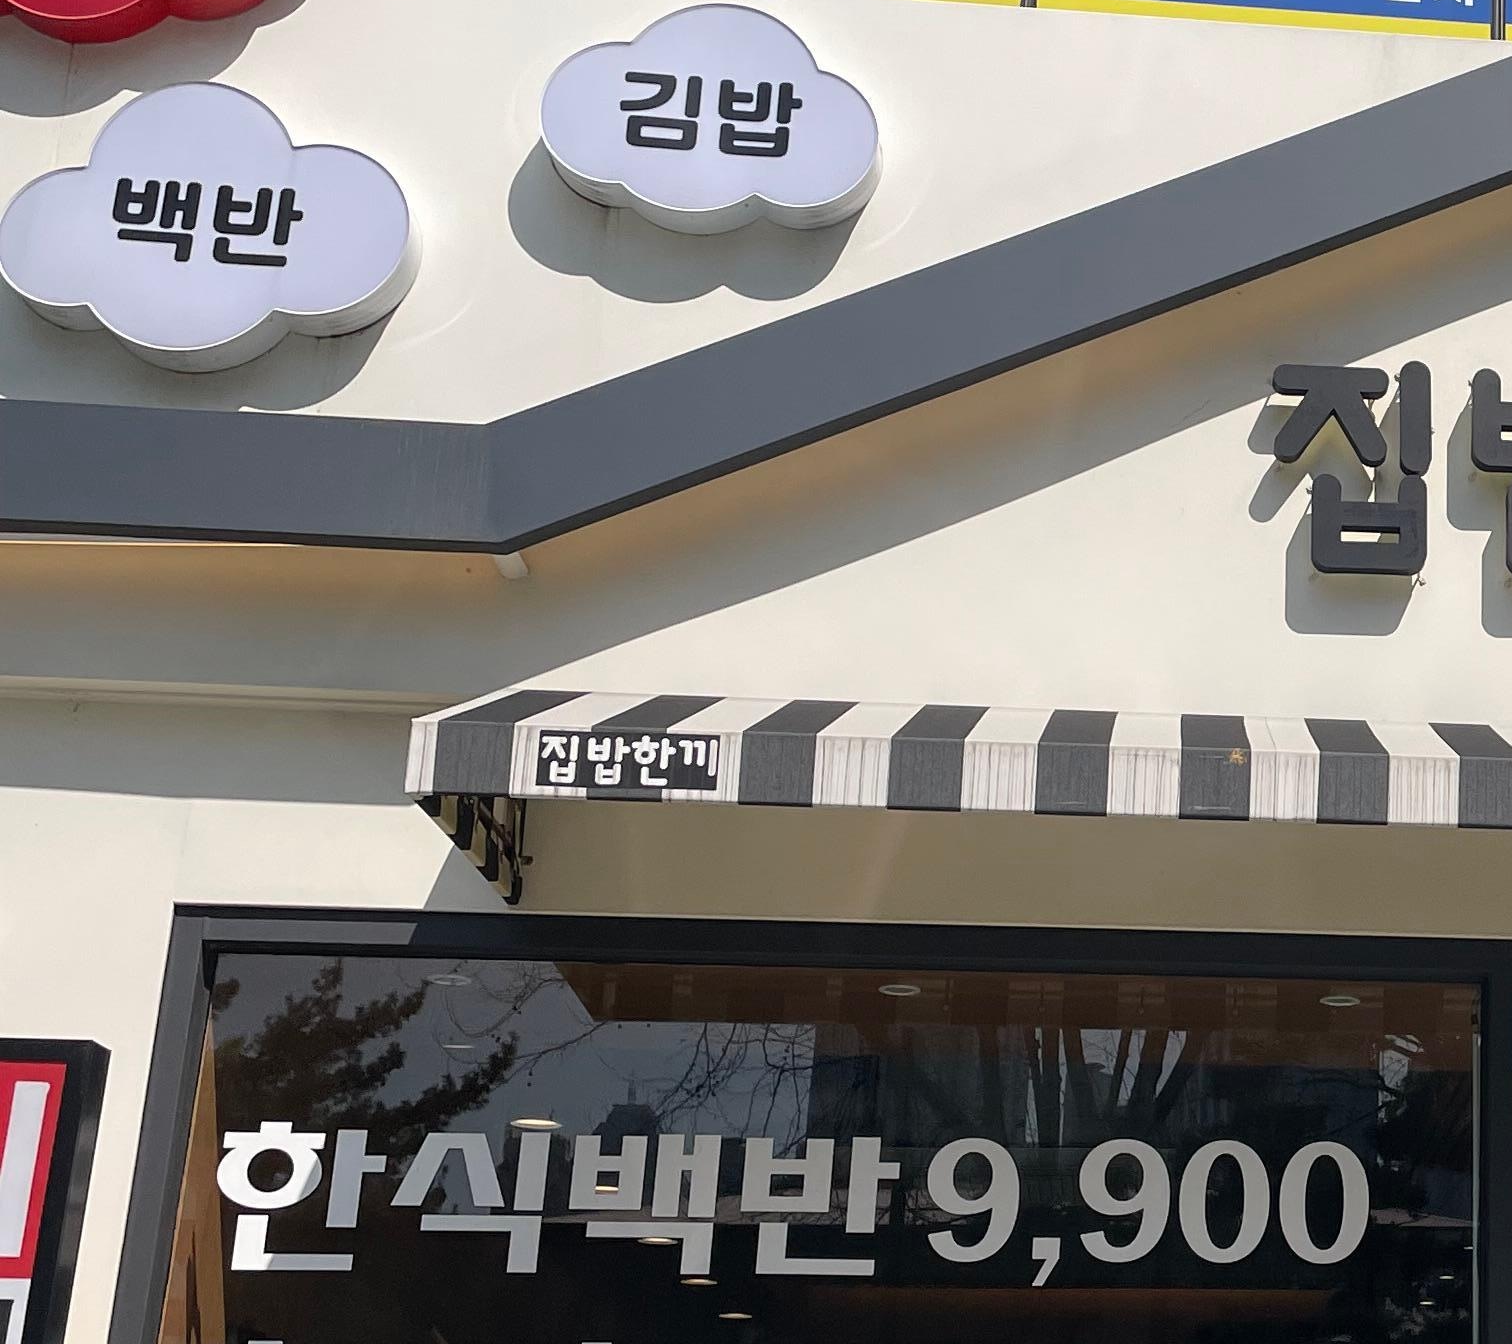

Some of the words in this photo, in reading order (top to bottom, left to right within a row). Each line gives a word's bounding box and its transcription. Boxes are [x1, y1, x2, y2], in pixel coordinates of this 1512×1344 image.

[621, 71, 802, 158] 김밥
[112, 178, 304, 267] 백반
[540, 734, 718, 787] 집밥한끼
